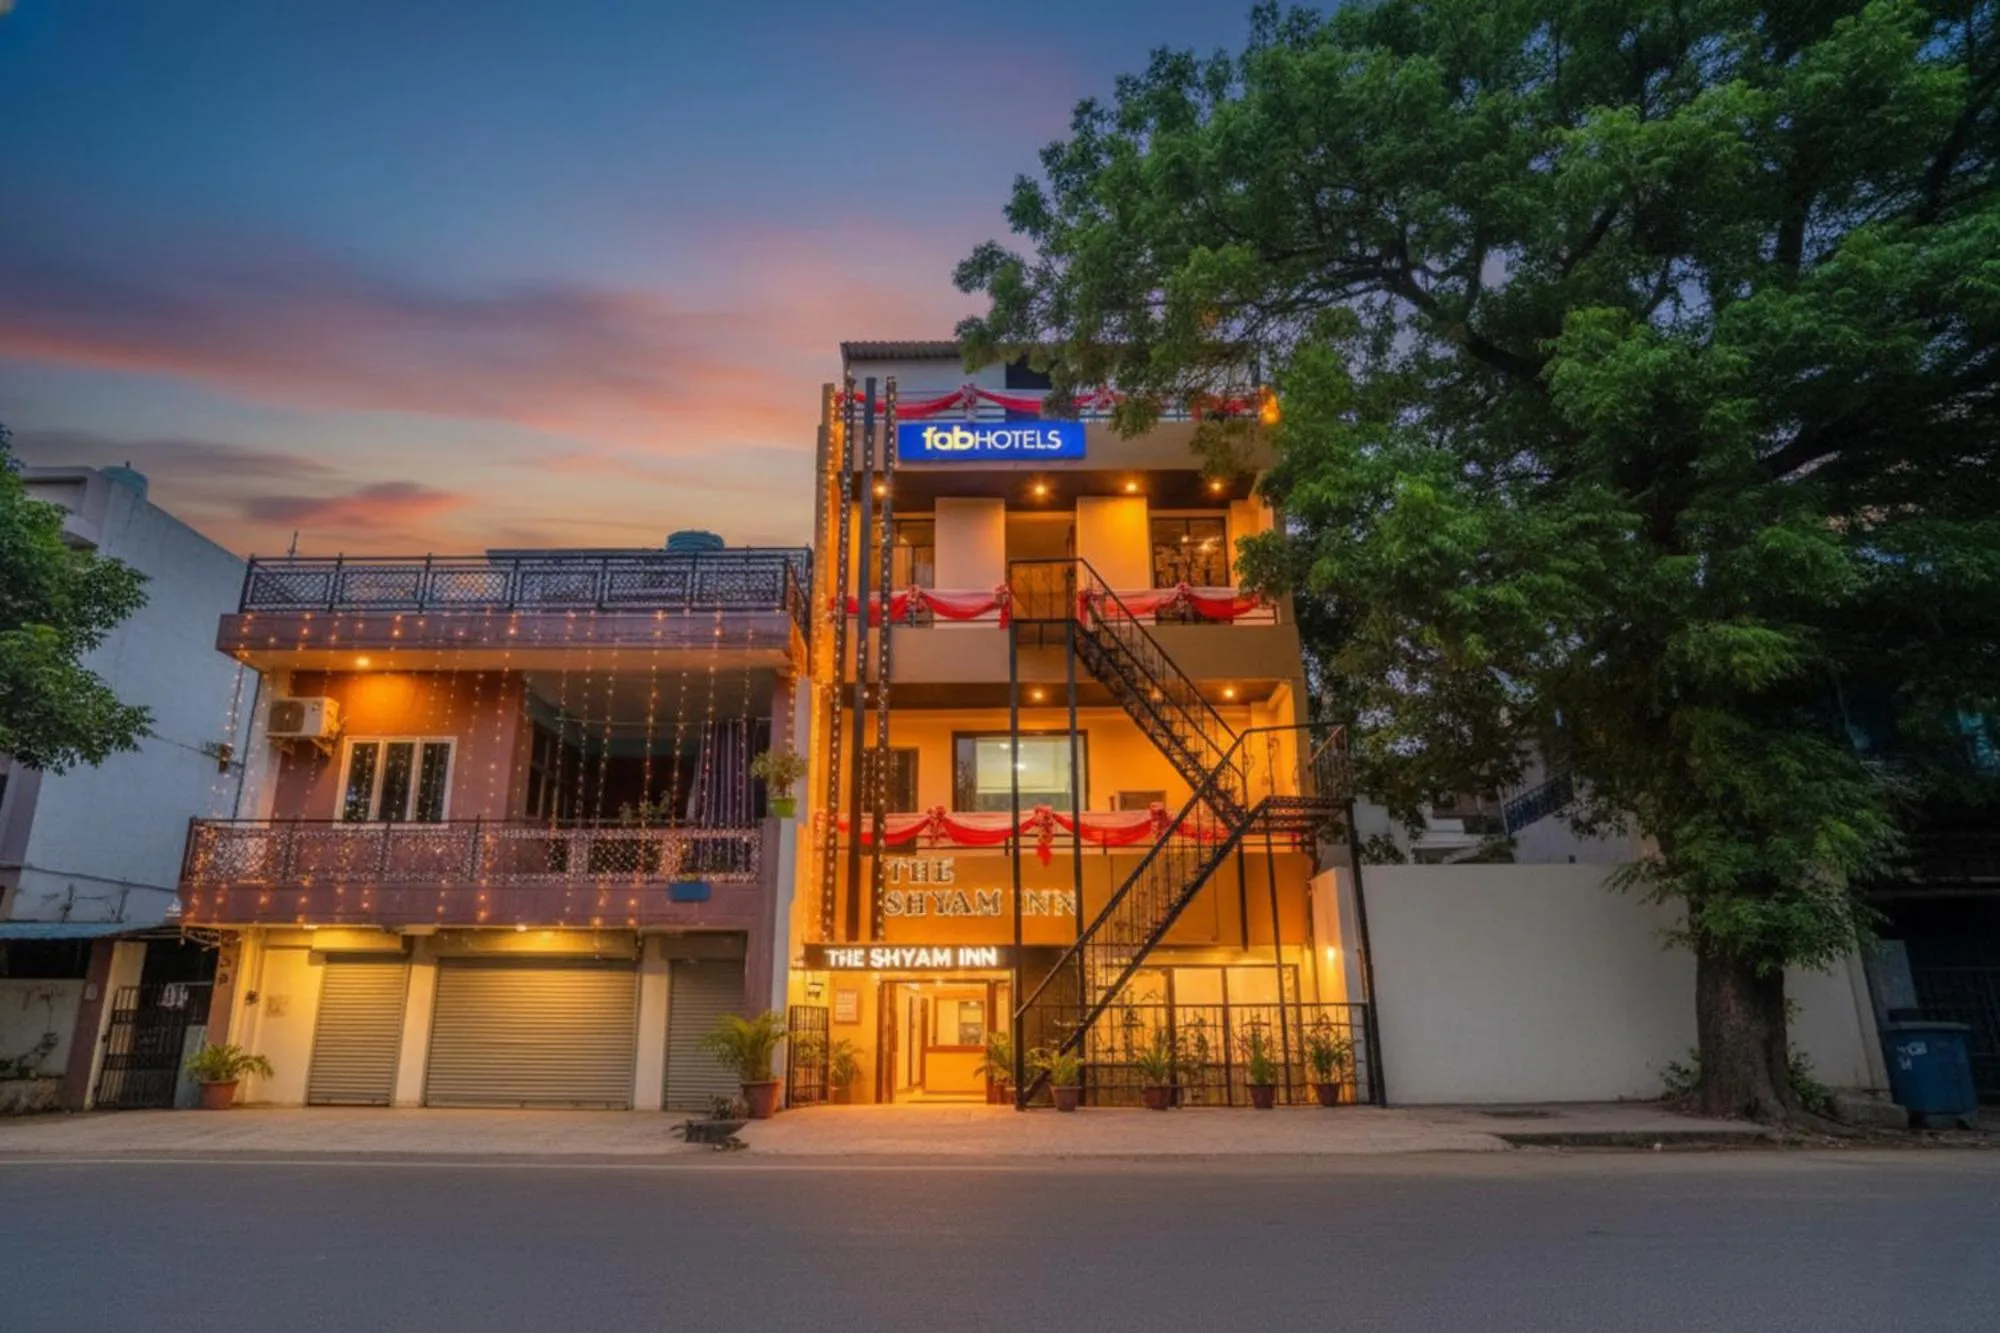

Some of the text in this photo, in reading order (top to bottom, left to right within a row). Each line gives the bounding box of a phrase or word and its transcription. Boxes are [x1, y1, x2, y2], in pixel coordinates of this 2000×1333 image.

[884, 857, 955, 885] THE
[884, 888, 1077, 917] SHYAM NN
[825, 945, 998, 968] THE SHYAM INN
